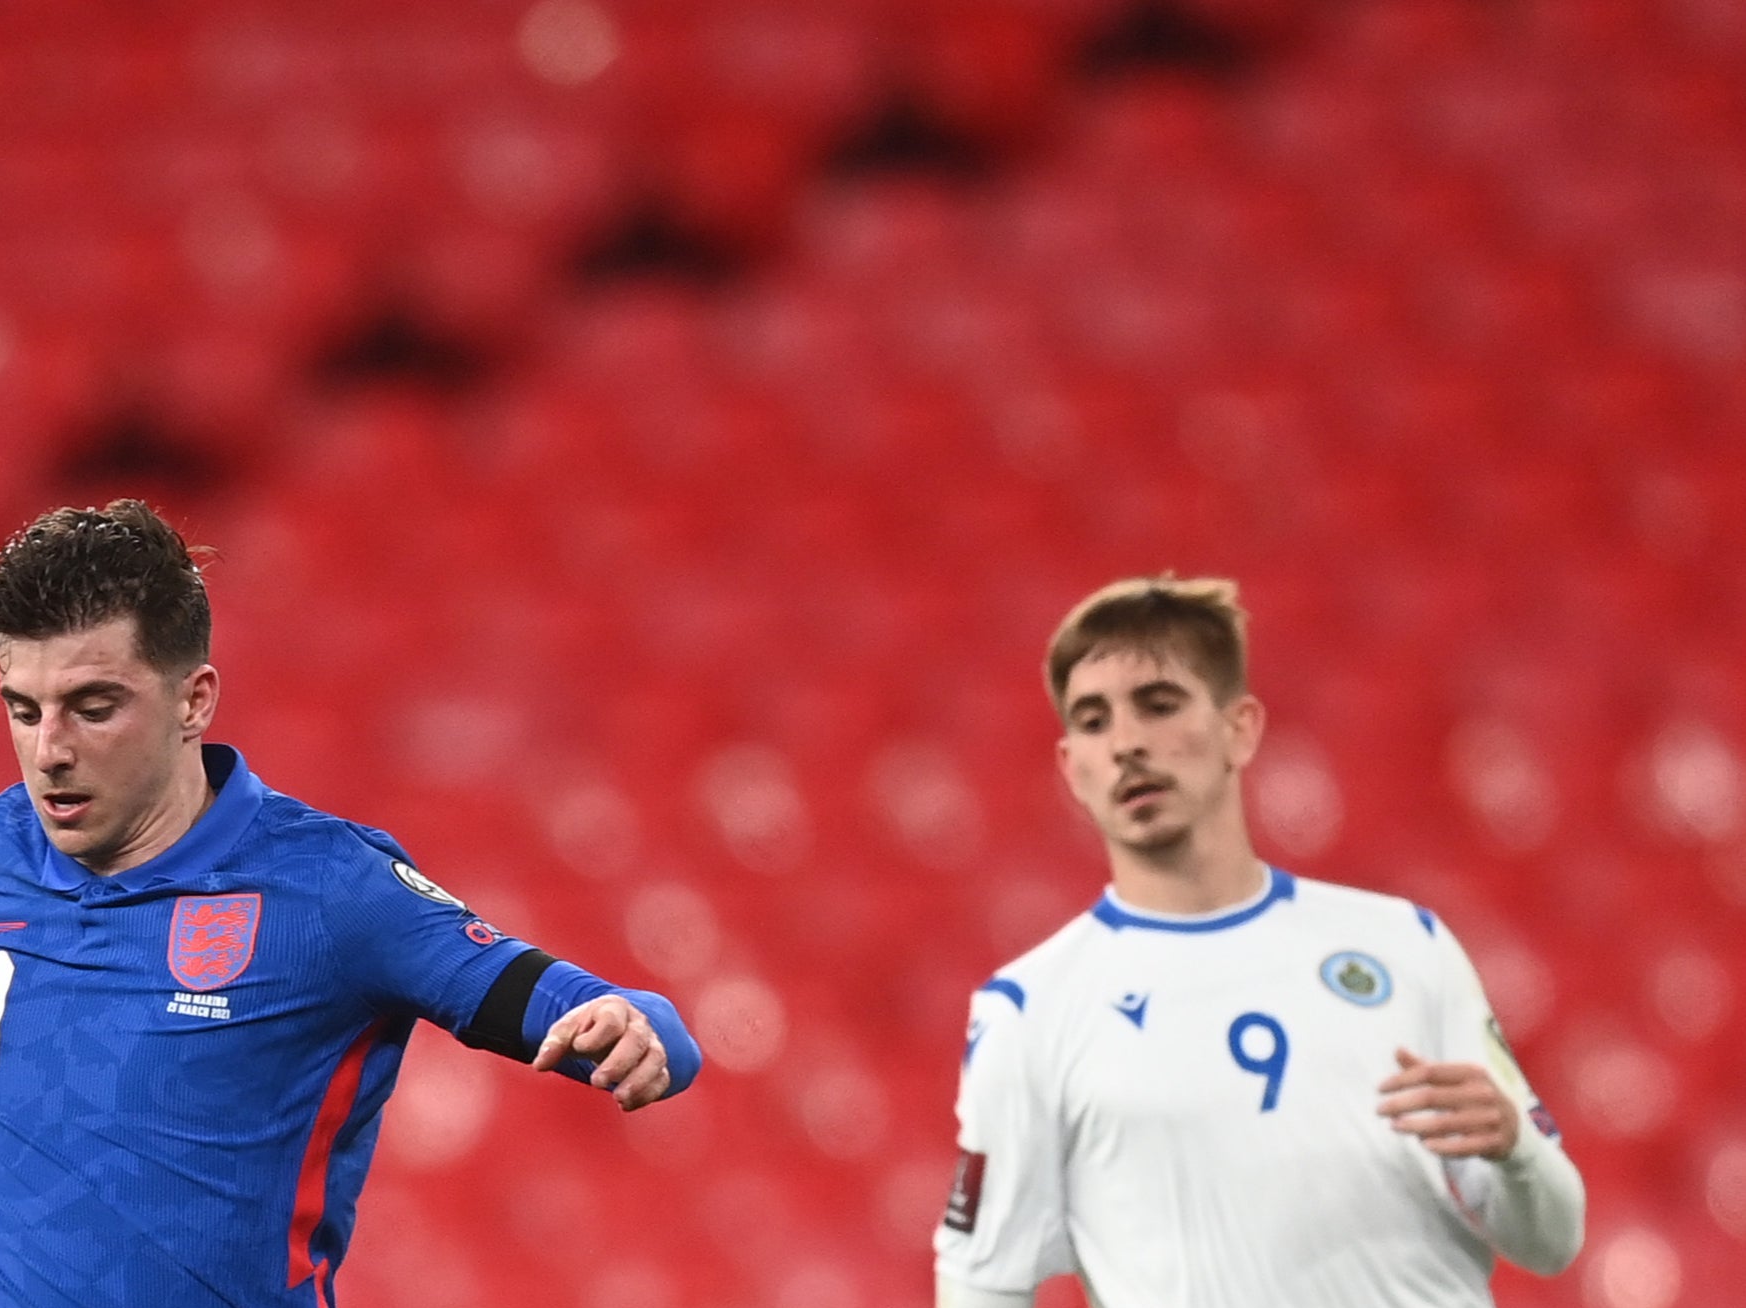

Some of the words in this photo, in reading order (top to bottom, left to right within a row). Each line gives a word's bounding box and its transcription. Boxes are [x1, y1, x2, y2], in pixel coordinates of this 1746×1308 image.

[174, 992, 192, 1003] SAN
[177, 1003, 210, 1017] MARCH
[1228, 1012, 1289, 1111] 9
